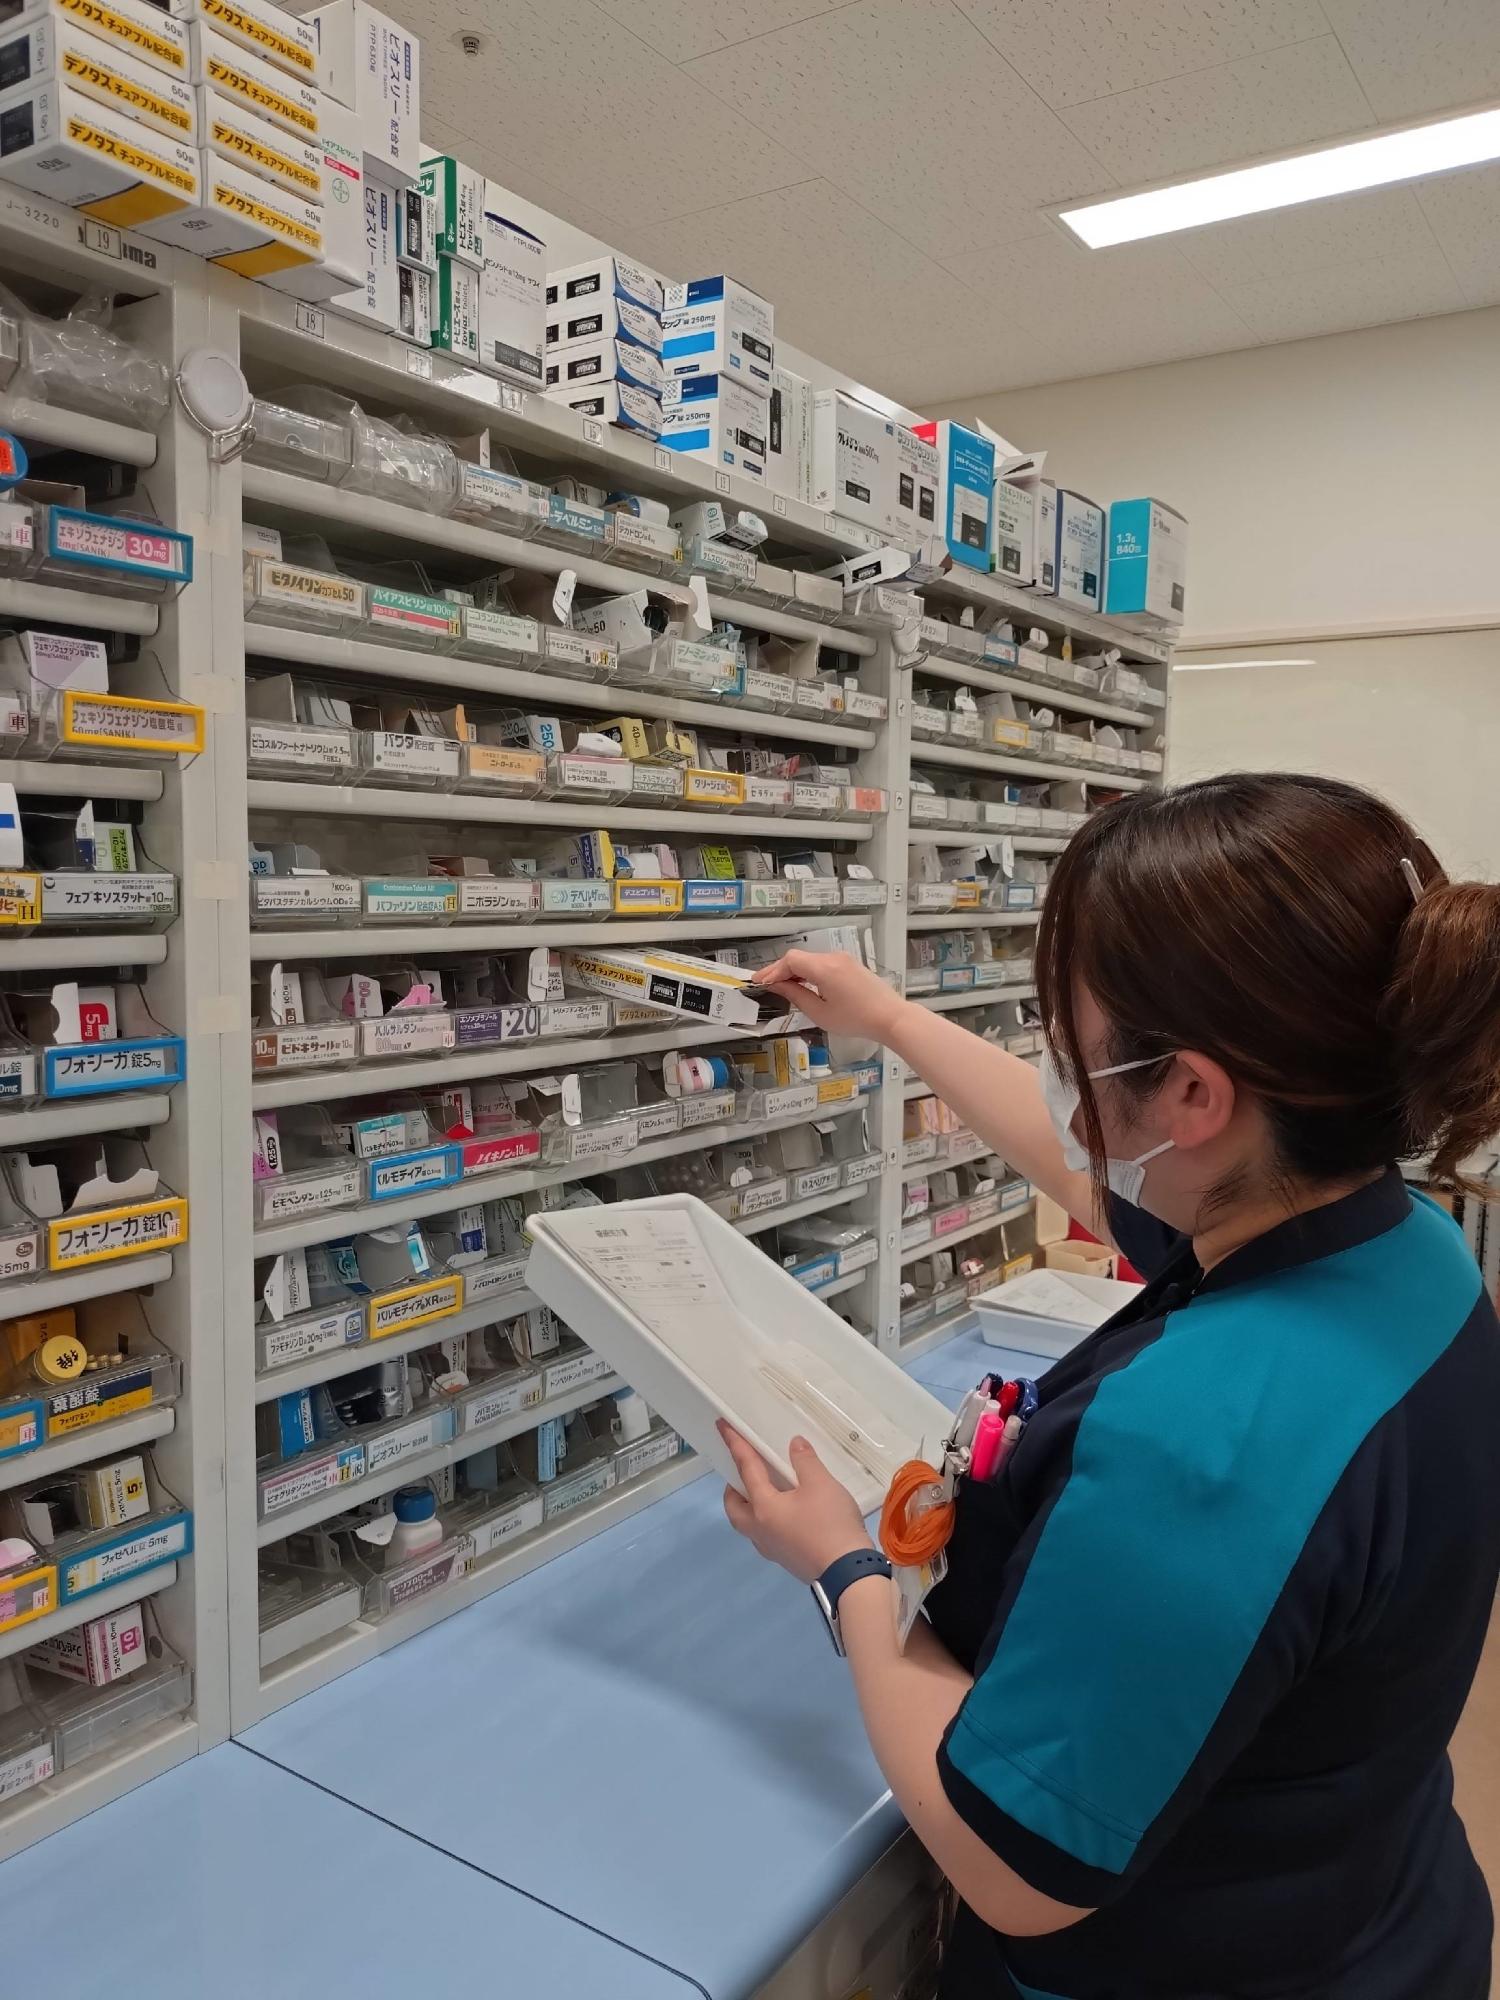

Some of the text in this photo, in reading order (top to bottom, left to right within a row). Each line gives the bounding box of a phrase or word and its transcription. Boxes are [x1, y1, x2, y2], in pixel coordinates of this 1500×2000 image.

[96, 229, 111, 250] 19
[305, 311, 316, 330] 18
[85, 1013, 101, 1038] 5mg
[253, 1038, 276, 1056] 10mg
[56, 1050, 162, 1076] フォシーガ錠5mg
[123, 1631, 136, 1654] 10
